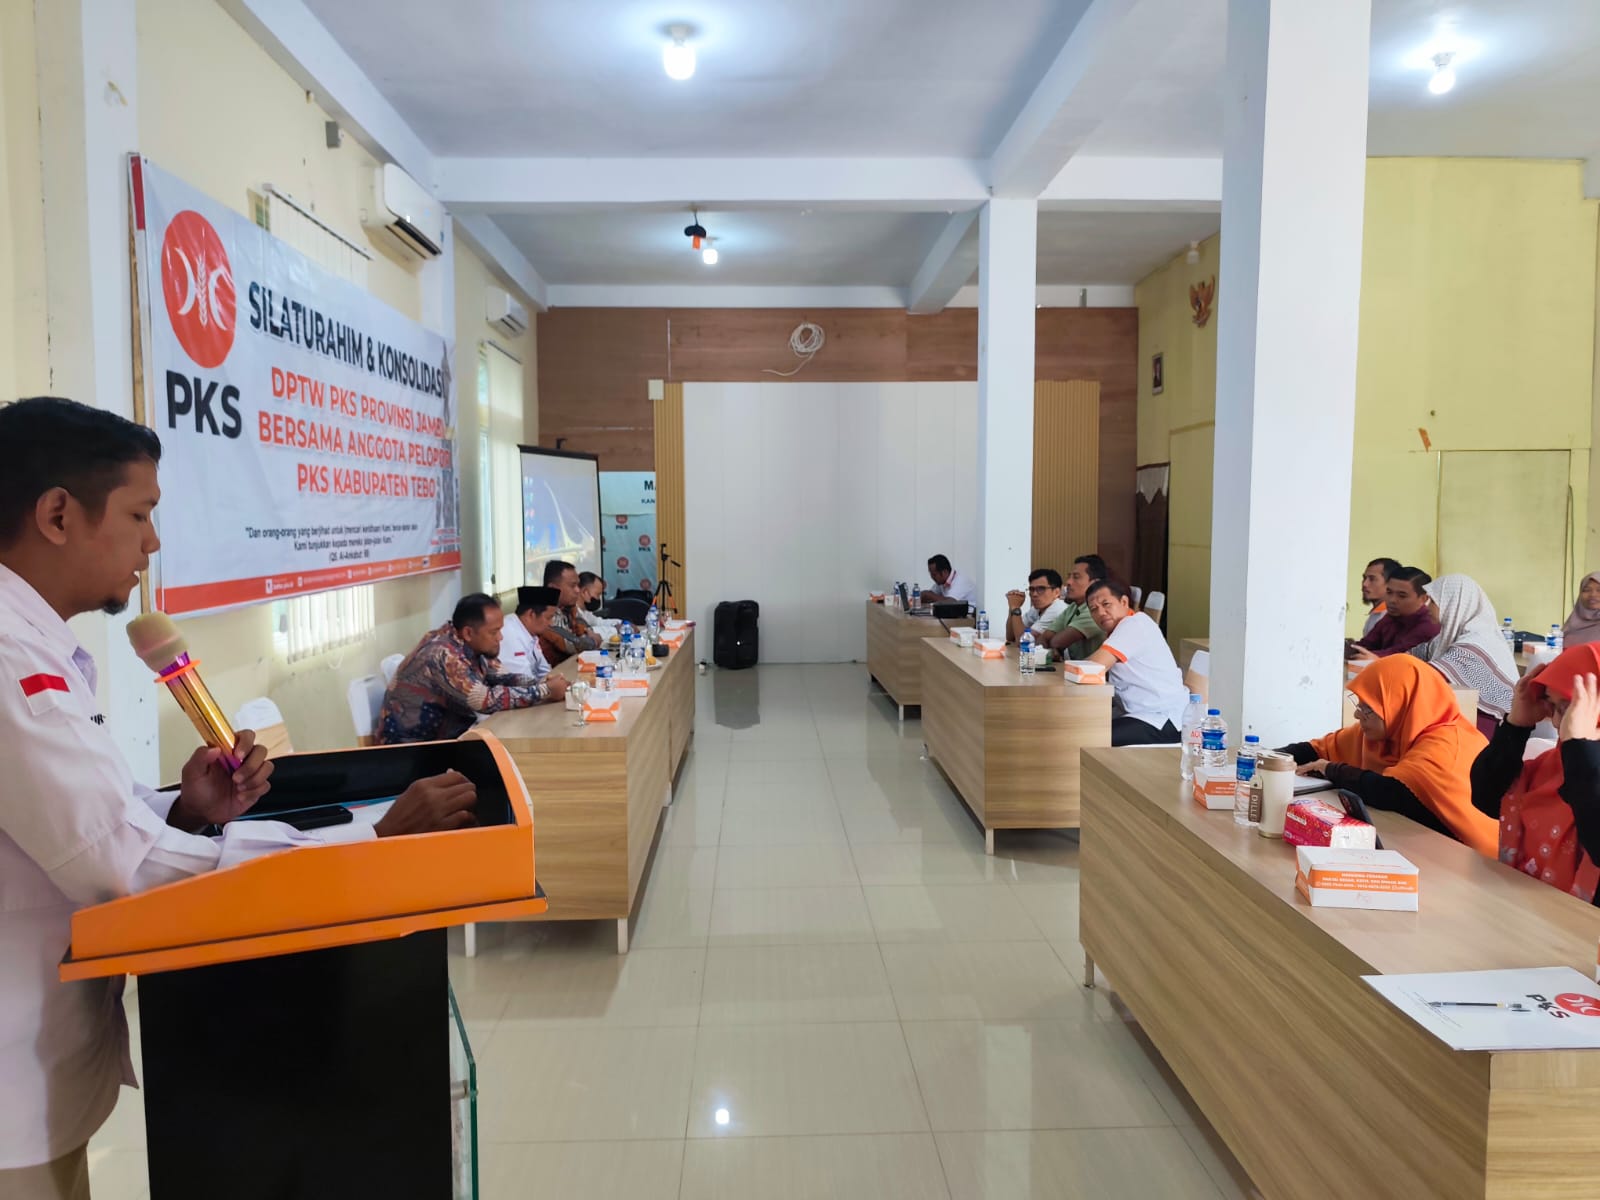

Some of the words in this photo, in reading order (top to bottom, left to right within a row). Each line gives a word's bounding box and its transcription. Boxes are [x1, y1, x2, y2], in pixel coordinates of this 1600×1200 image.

[249, 281, 363, 368] SILATURAHIM
[367, 336, 375, 372] &
[166, 369, 242, 439] PKS
[271, 366, 325, 408] DPTW
[330, 385, 358, 417] PKS
[361, 395, 414, 432] PROVINSI
[258, 410, 344, 454] BERSAMA
[348, 430, 407, 462] ANGGOTA
[297, 463, 329, 494] PKS
[333, 467, 409, 497] KABUPATEN
[411, 476, 436, 498] TEBO
[1525, 994, 1571, 1019] PKS
